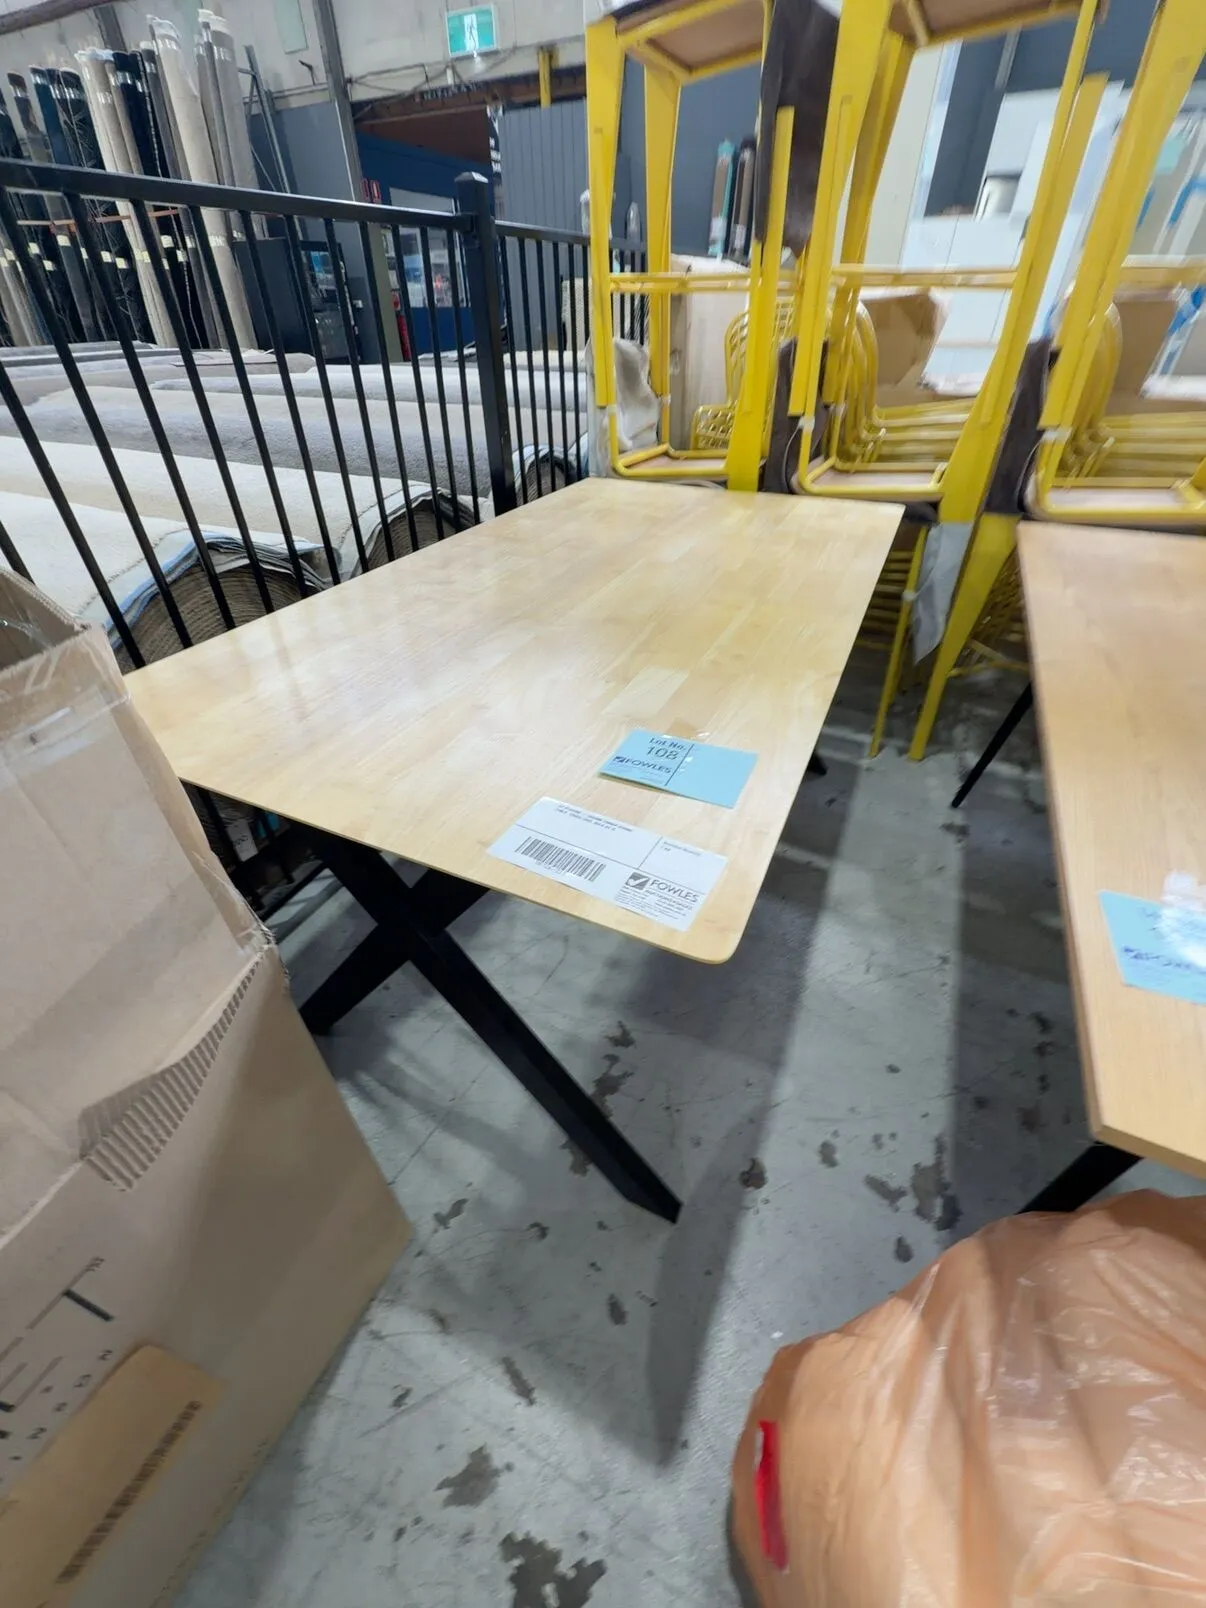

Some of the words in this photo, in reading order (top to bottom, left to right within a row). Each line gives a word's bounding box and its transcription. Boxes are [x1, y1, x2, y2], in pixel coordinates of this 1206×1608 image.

[648, 738, 667, 746] Lot
[646, 746, 680, 760] 108
[624, 757, 673, 774] FOWLES
[650, 879, 699, 903] FOWLES
